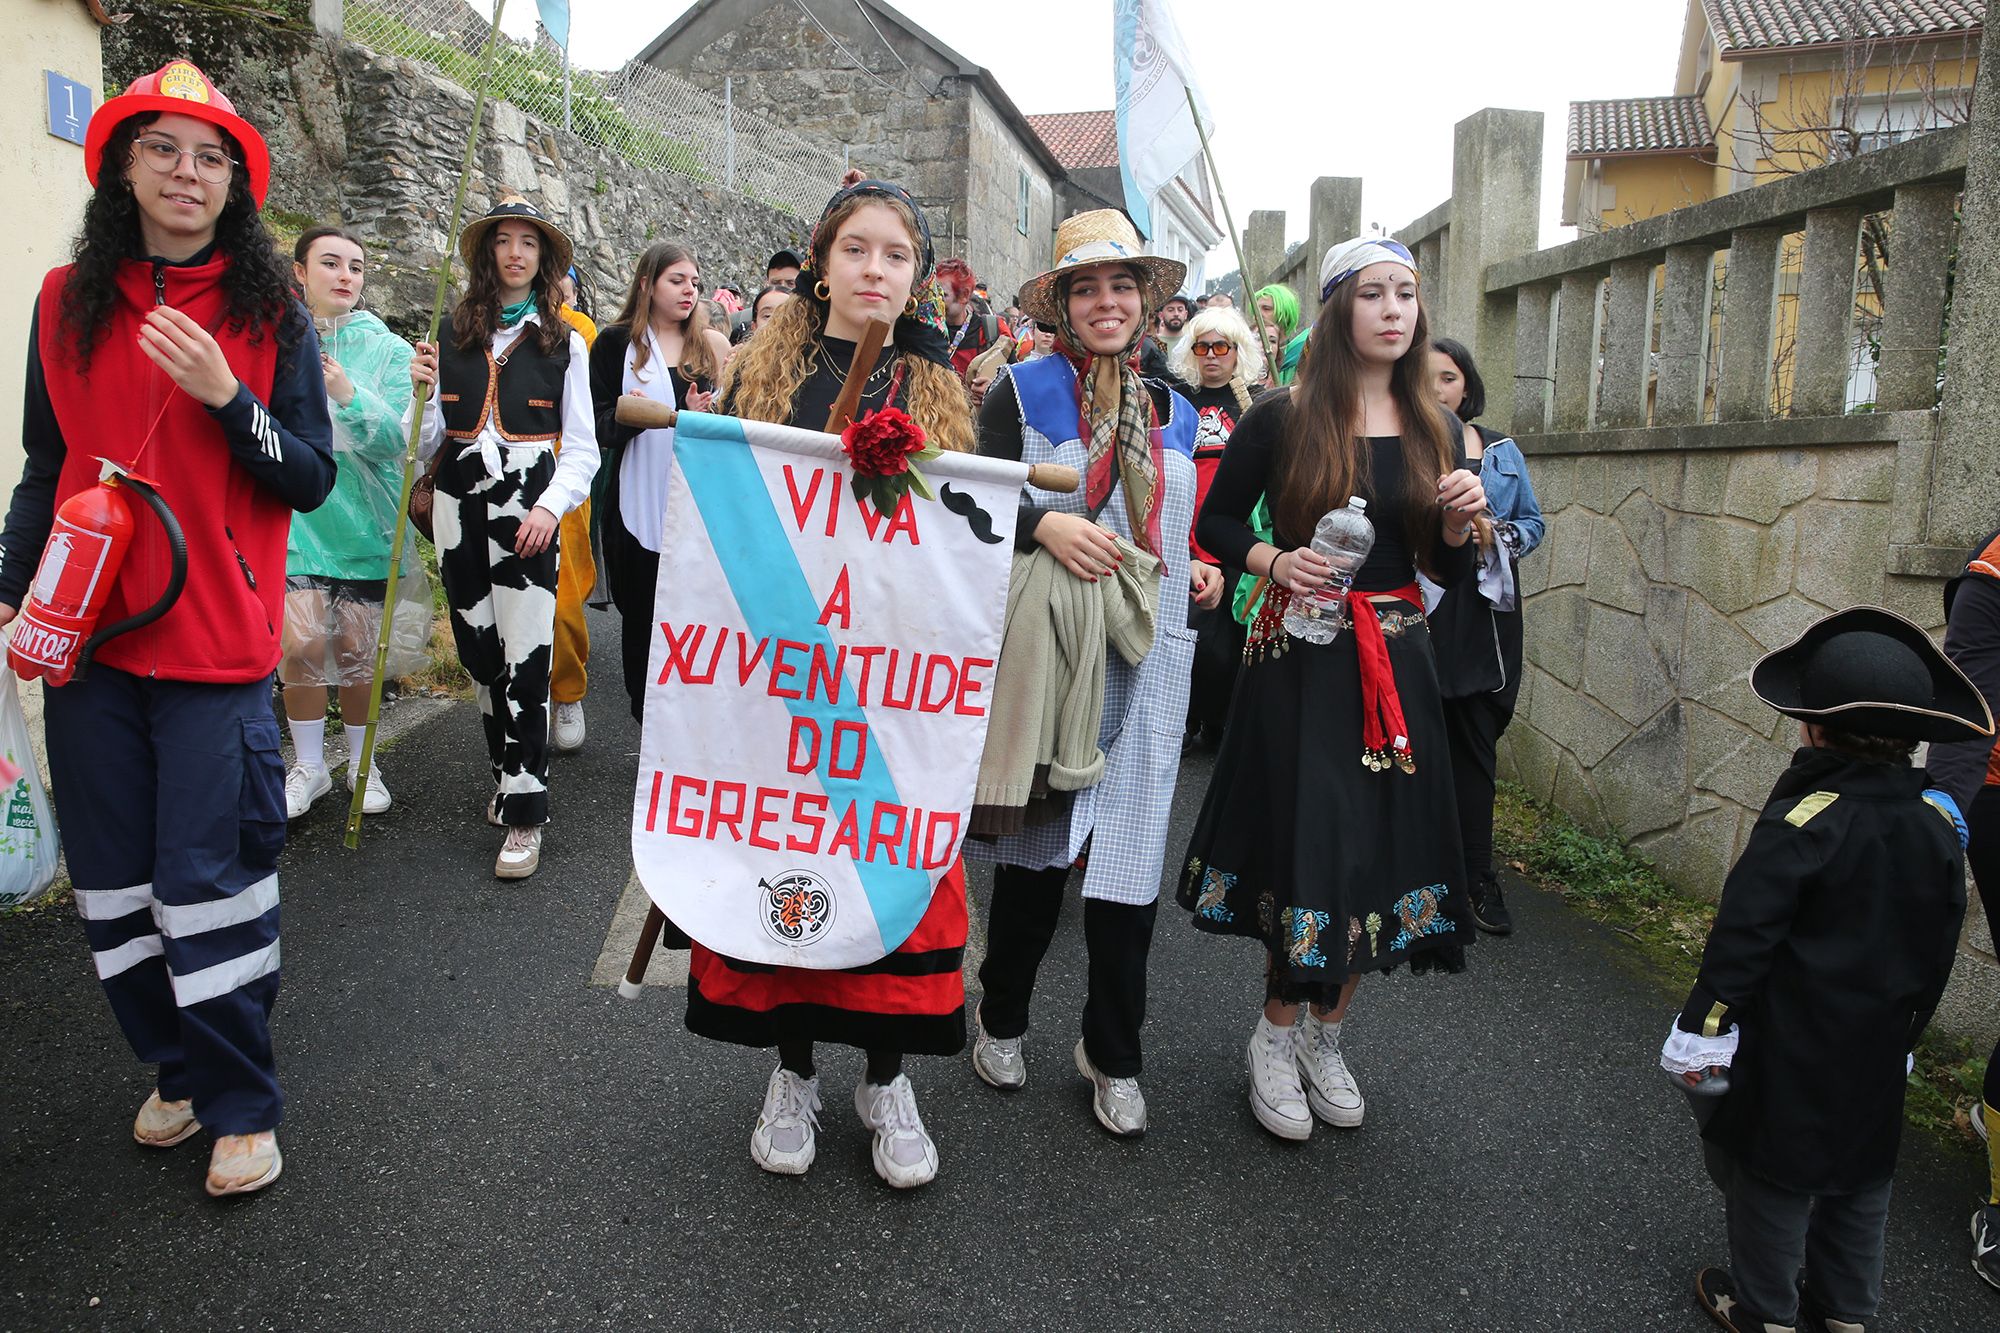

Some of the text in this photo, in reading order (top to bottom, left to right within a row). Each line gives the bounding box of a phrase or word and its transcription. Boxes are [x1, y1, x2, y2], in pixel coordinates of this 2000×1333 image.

[63, 85, 79, 122] 1
[166, 75, 202, 87] CHIEF
[171, 68, 197, 78] FIRE
[782, 464, 921, 546] VIVA
[817, 563, 851, 630] A
[657, 621, 994, 717] XUVENTUDE
[787, 715, 869, 780] DO
[645, 770, 961, 870] IGRESARIO
